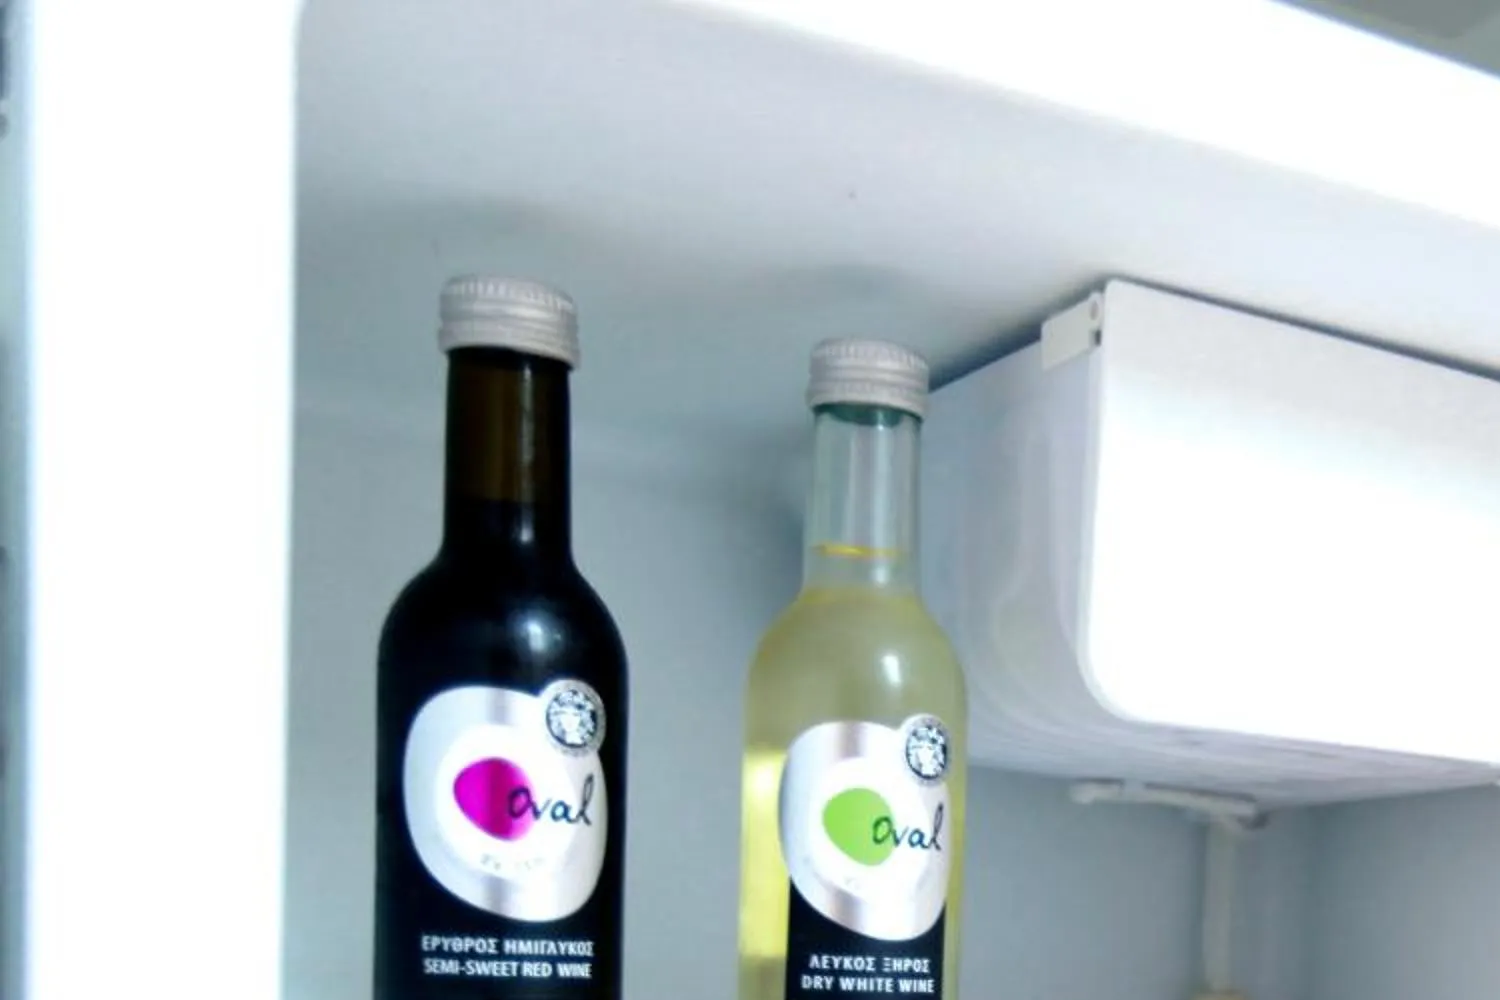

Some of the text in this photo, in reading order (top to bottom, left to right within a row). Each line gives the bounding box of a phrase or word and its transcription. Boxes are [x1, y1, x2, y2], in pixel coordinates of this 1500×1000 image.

[421, 935, 500, 954] ΕΡΥΘΡΟΣ
[424, 957, 593, 979] SEMI-SWEET RED WINE
[808, 953, 931, 973] ΛΕΥΚΟΣ ΞΗΡΟΣ
[801, 973, 936, 994] DRY WHITE WINE
